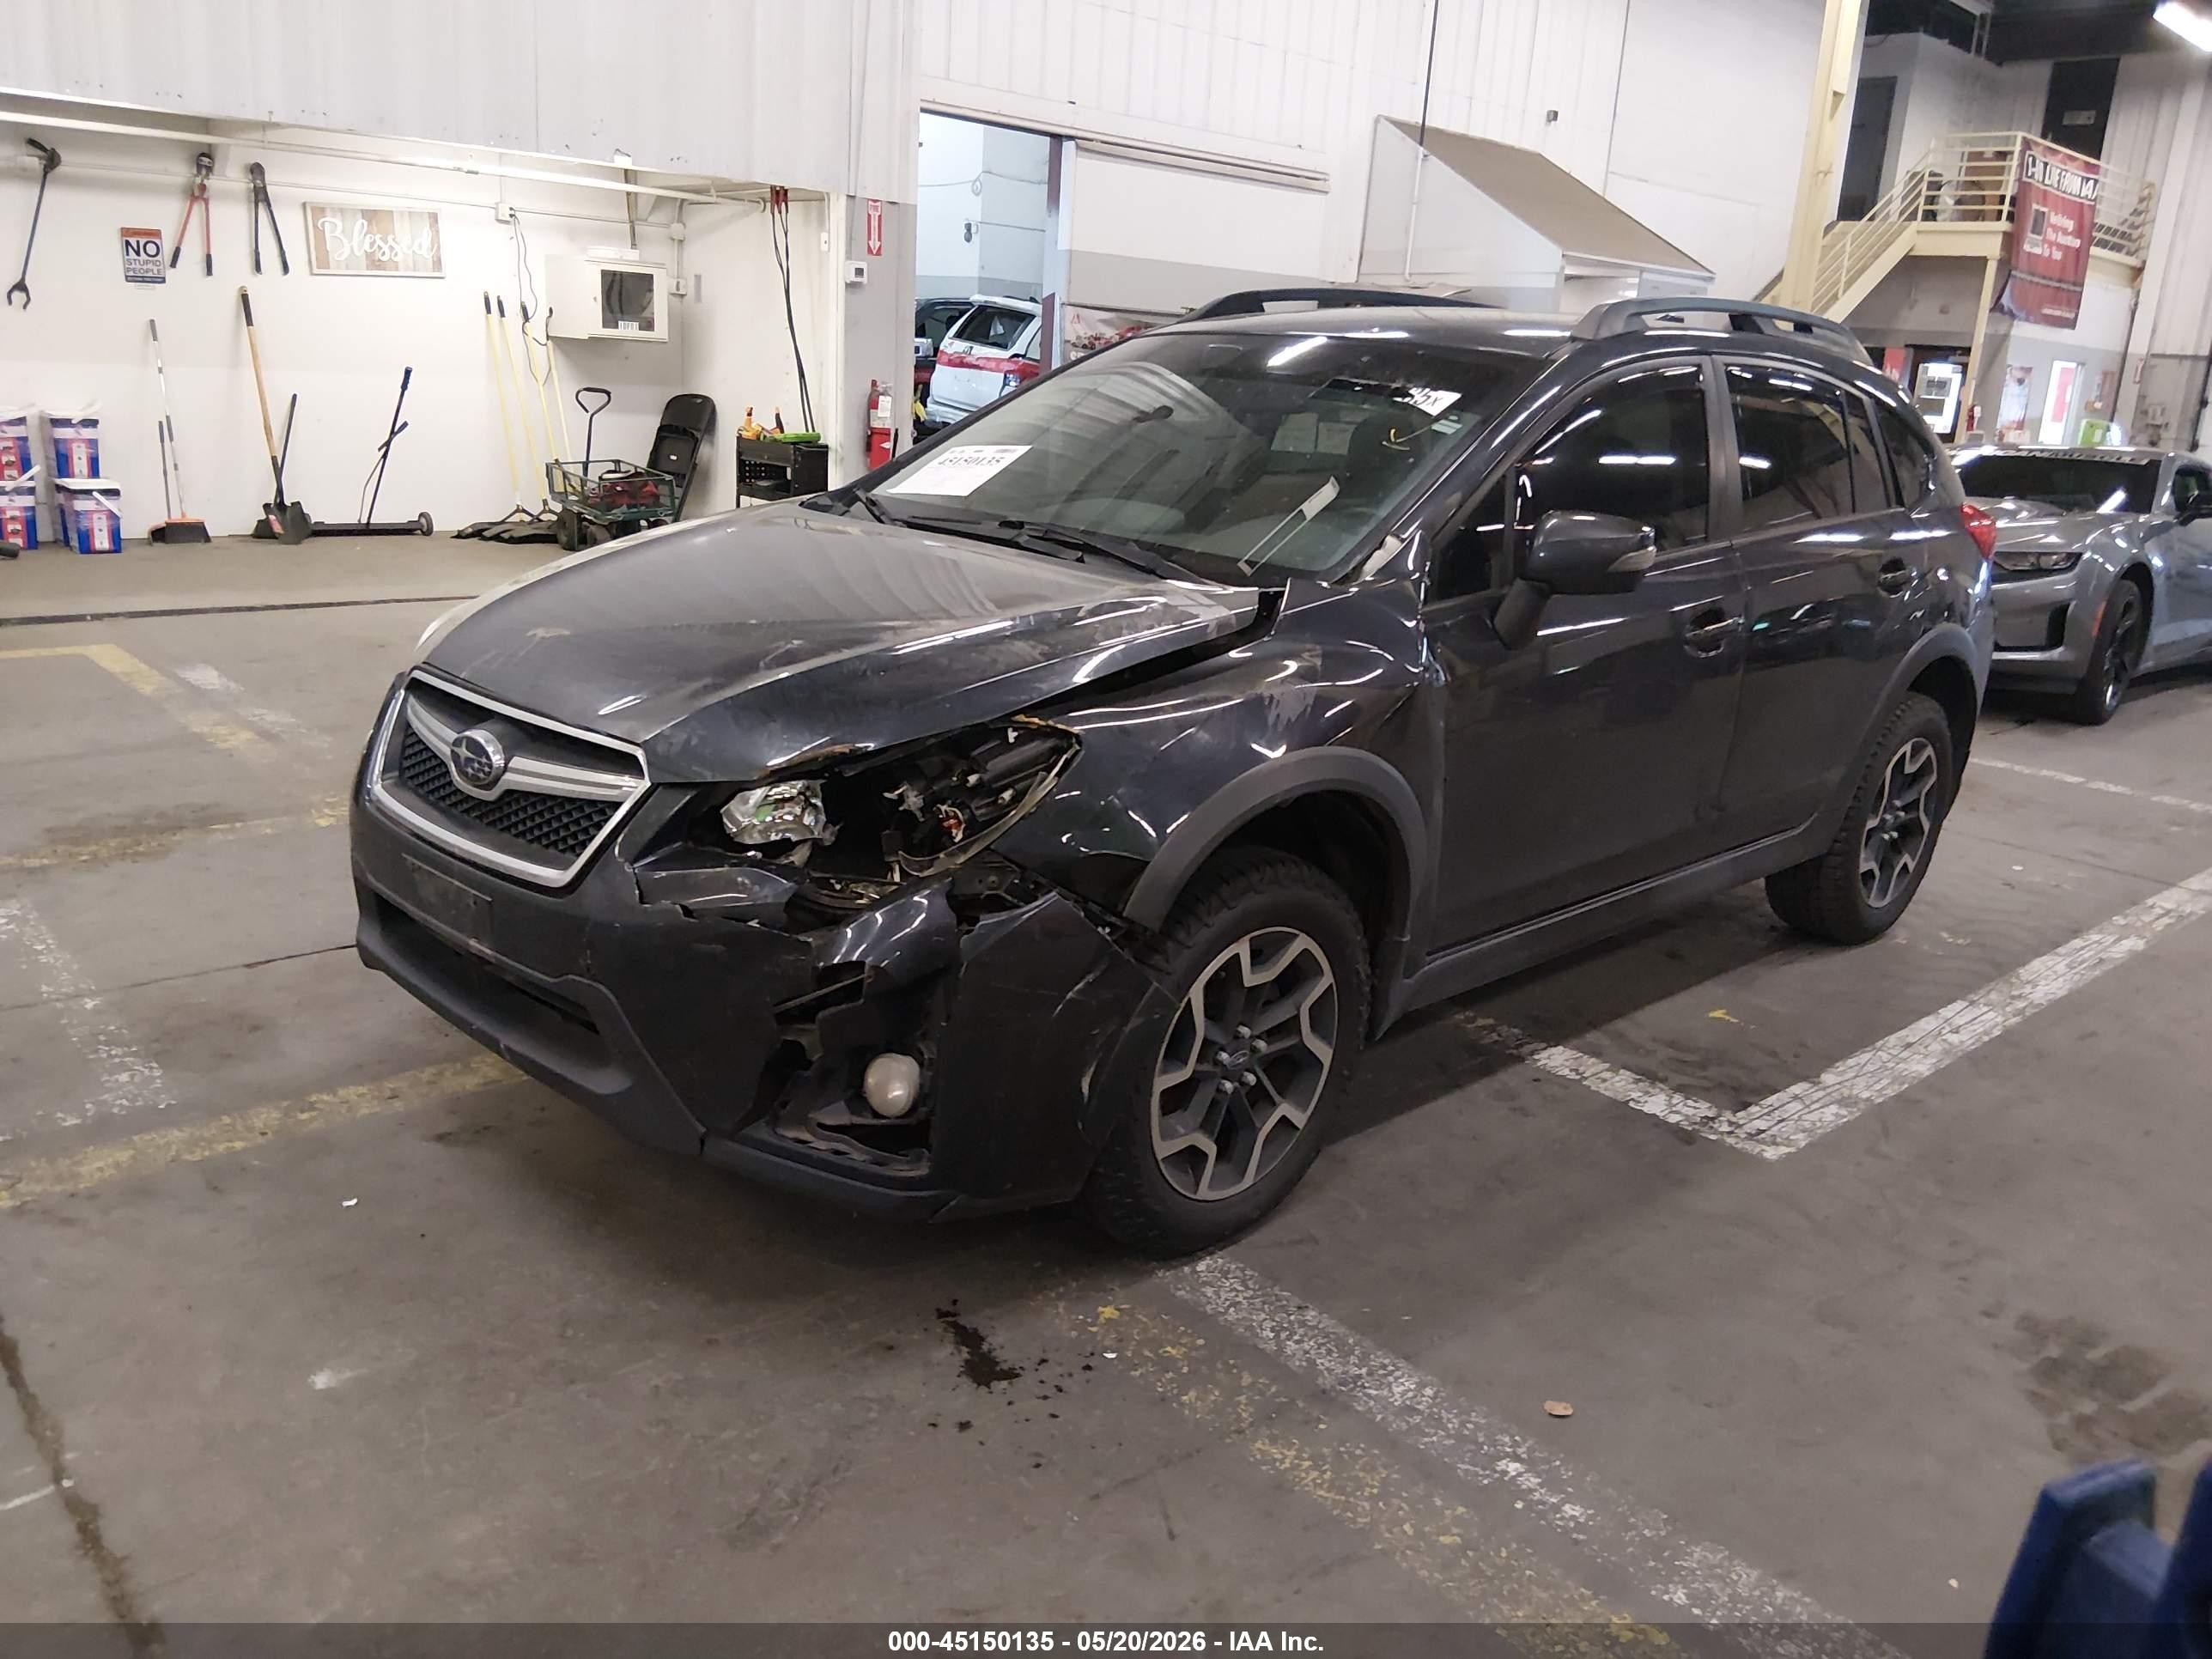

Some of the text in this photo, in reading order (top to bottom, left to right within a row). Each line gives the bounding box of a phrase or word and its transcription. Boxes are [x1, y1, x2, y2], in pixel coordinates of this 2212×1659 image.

[318, 217, 438, 261] Blessed
[125, 240, 161, 258] NO
[126, 258, 161, 267] STUPID
